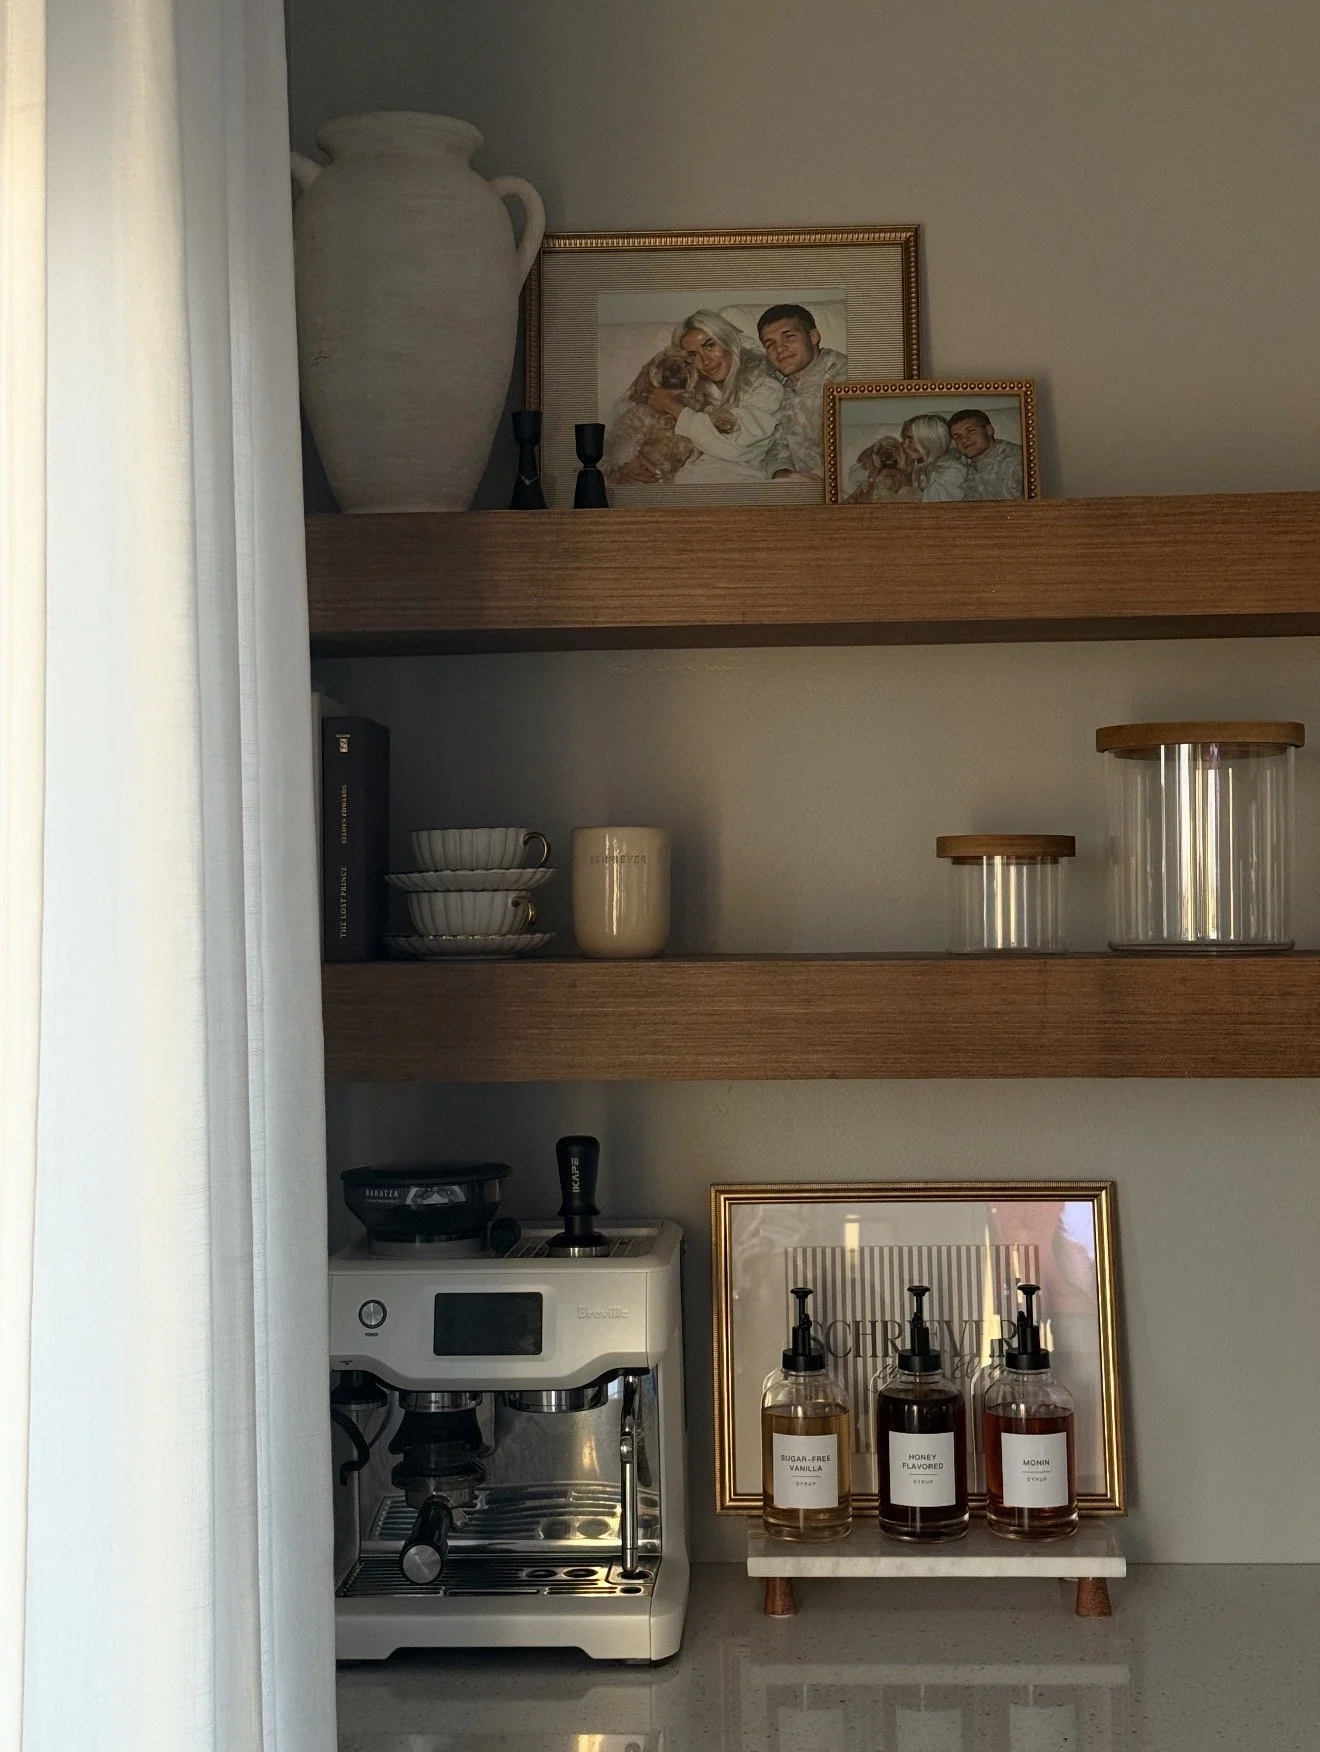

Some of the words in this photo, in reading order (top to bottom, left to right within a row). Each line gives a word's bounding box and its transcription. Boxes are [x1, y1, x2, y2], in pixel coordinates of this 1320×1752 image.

[571, 1157, 580, 1193] IKAPE
[577, 1305, 629, 1320] Breville
[811, 1319, 1018, 1358] CHREVER
[780, 1454, 832, 1463] SUGAR-FREE
[902, 1462, 944, 1470] FLAVORED
